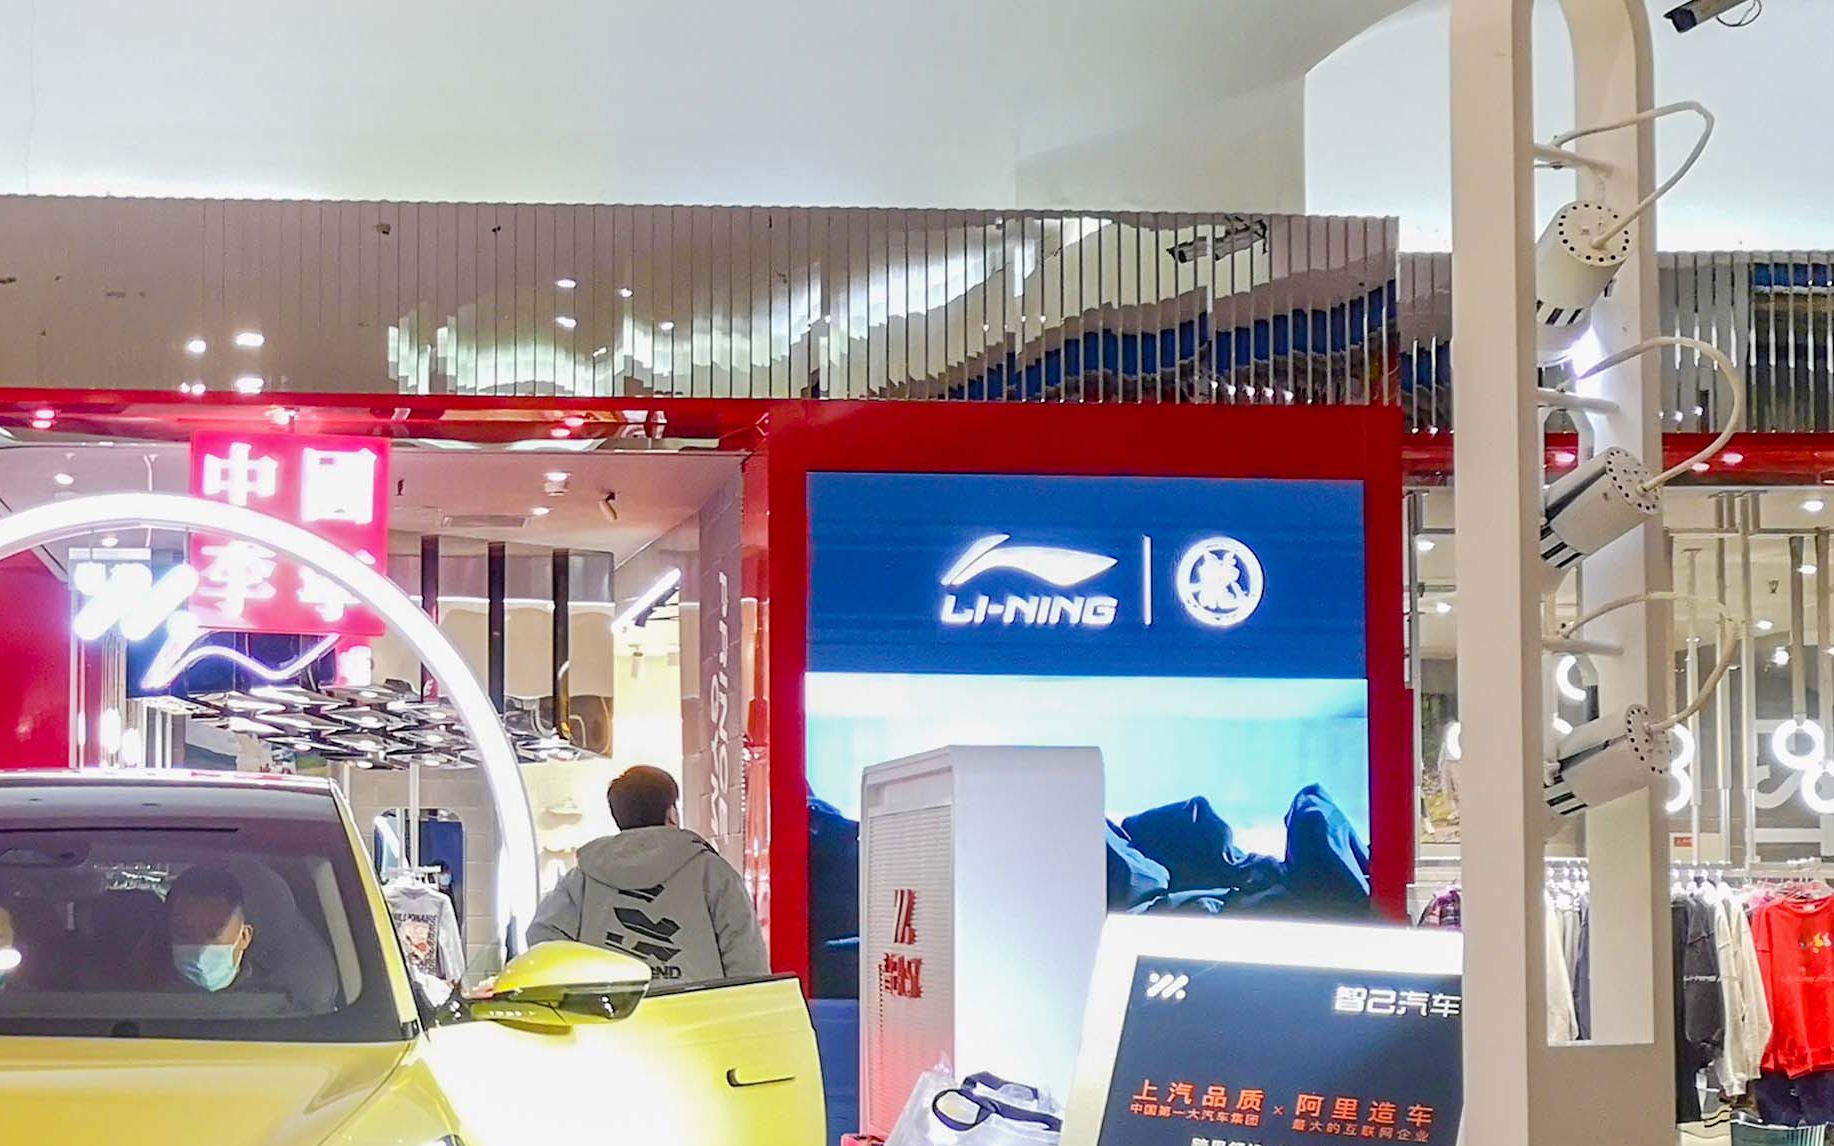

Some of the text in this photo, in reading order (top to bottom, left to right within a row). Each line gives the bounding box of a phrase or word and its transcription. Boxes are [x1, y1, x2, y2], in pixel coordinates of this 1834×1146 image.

[941, 595, 1118, 626] LI-NING
[1335, 985, 1462, 1018] 智己汽车
[1132, 1079, 1264, 1112] 上汽品质
[1295, 1094, 1434, 1127] 阿里造车
[1130, 1103, 1430, 1142] 中国第一大汽车集团 最大的互联网企业
